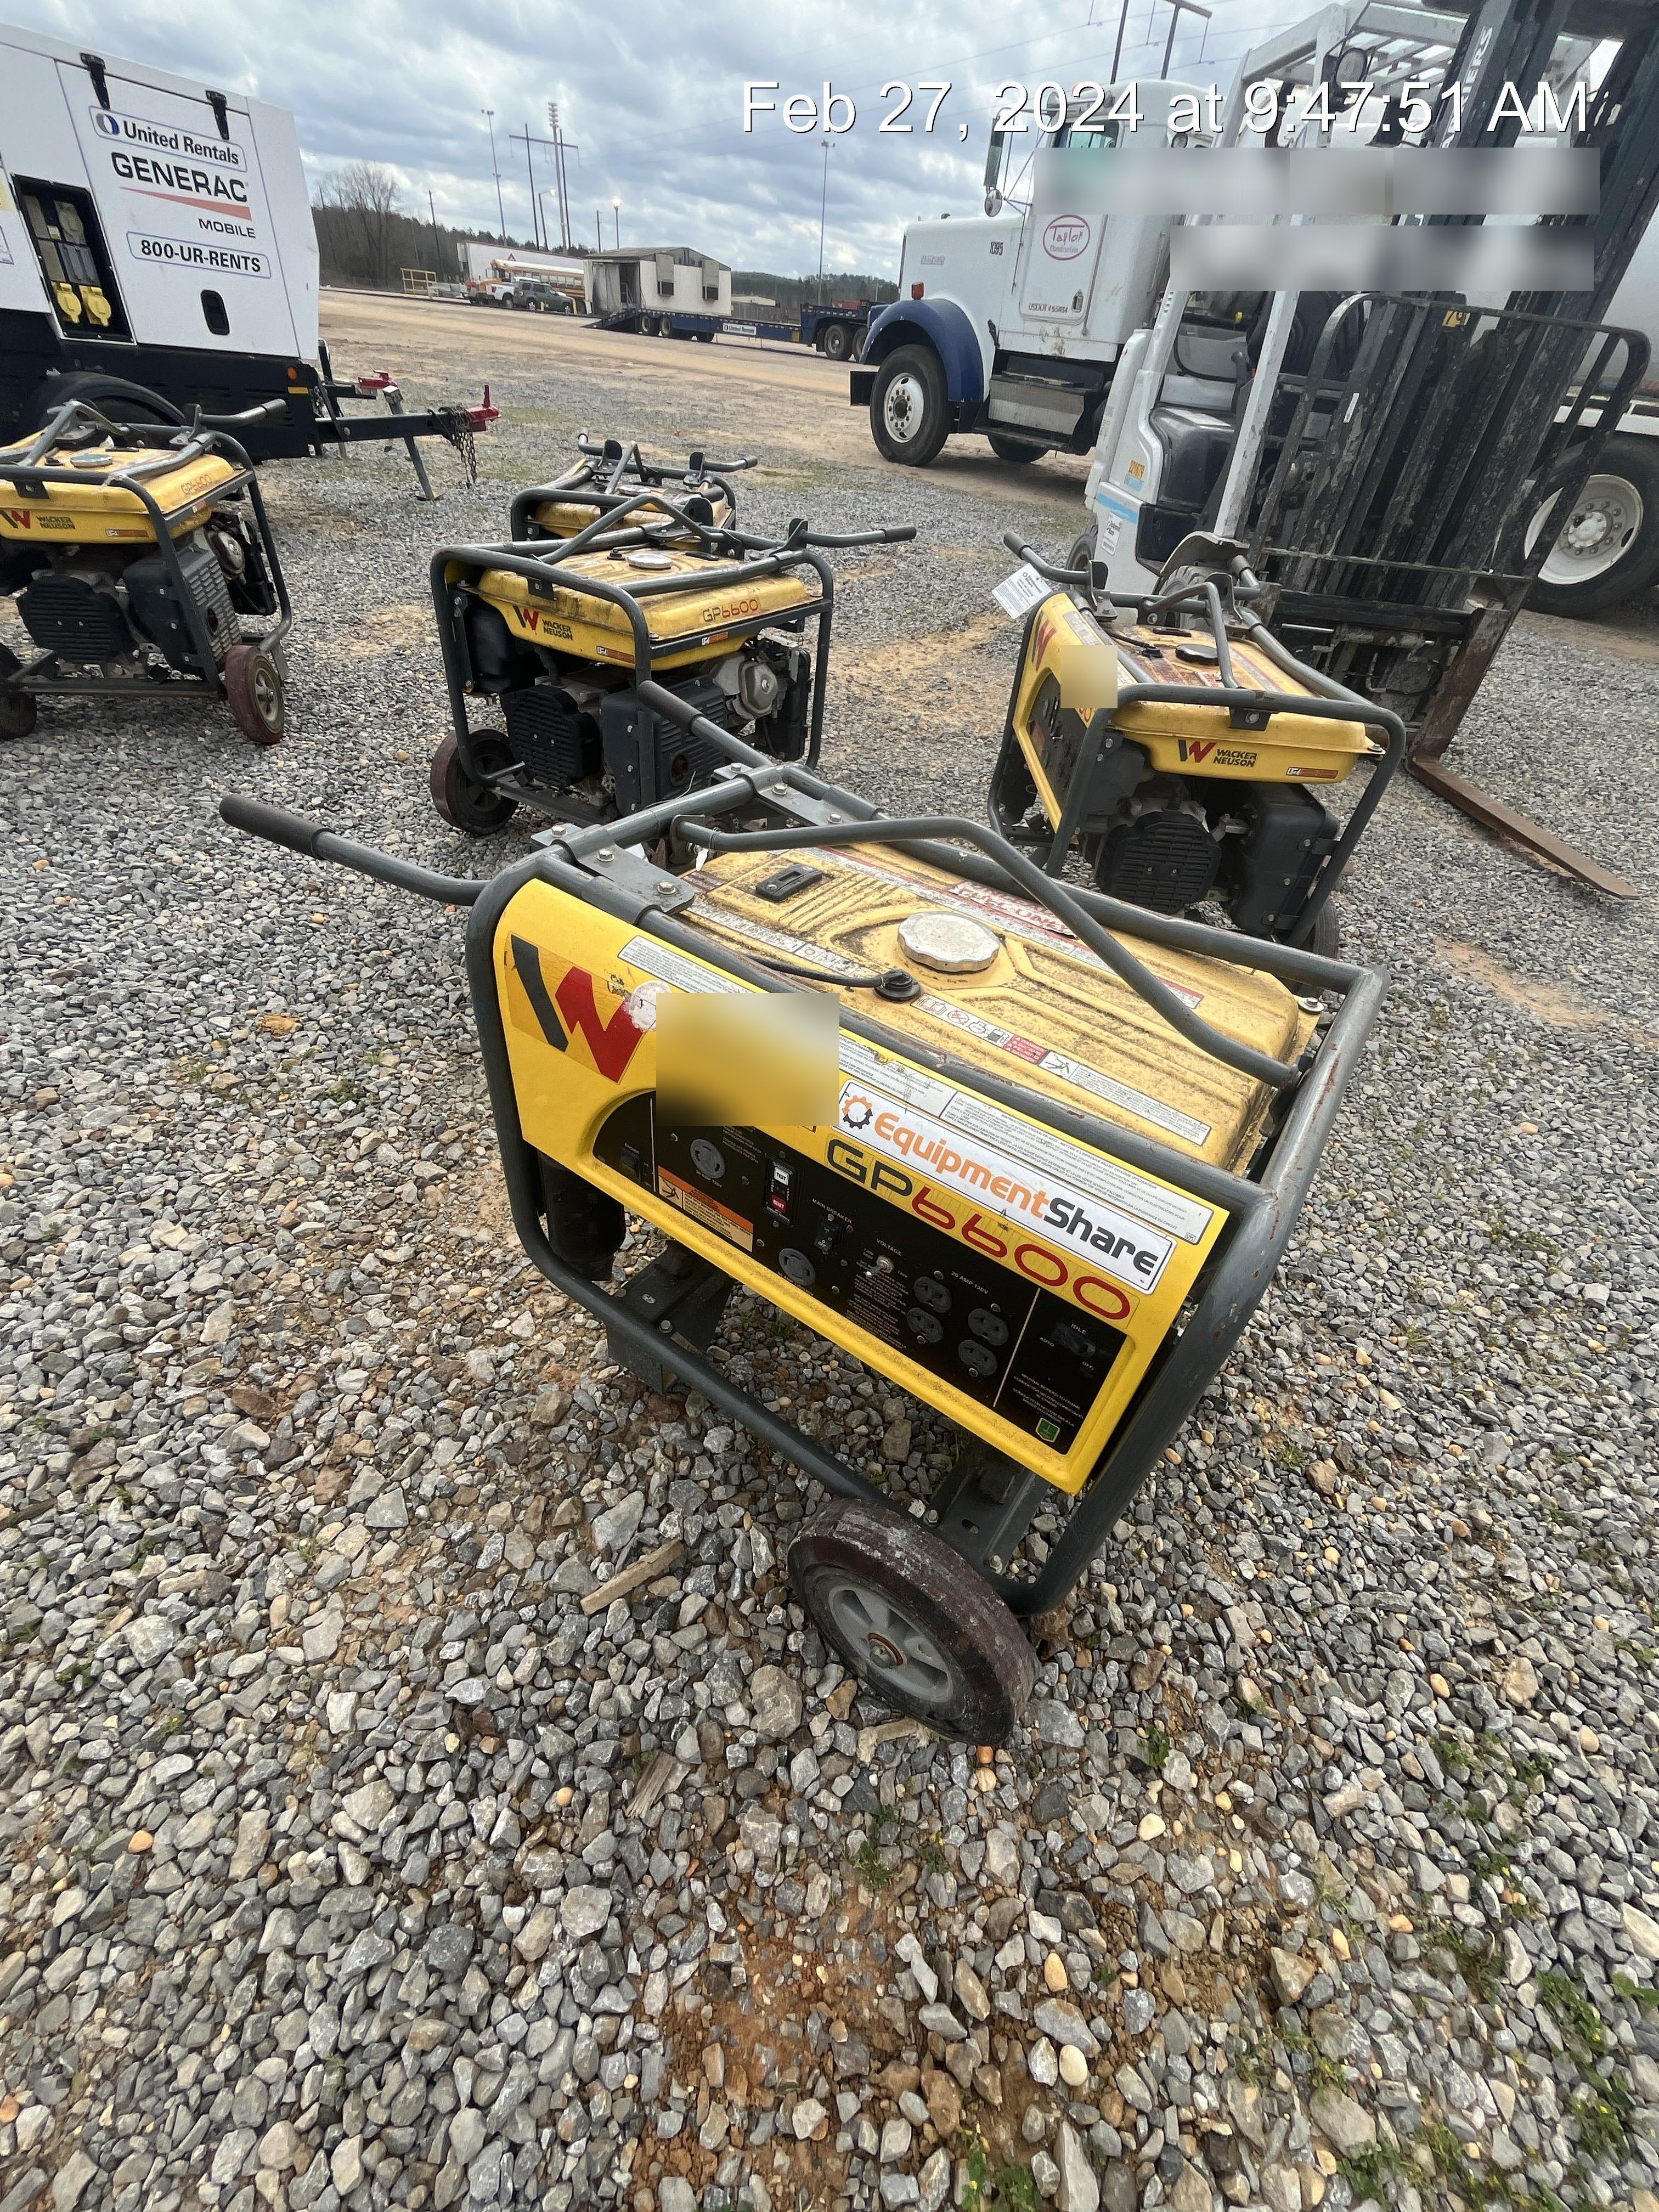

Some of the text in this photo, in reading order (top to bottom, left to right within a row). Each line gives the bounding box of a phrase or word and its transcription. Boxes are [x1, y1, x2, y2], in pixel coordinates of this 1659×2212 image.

[123, 122, 239, 165] United Rentals
[112, 153, 247, 202] GENERAC
[199, 218, 256, 239] MOBILE
[1049, 224, 1085, 246] Taylor
[141, 239, 261, 273] 800-UR-RENTS
[990, 241, 1003, 255] 1095
[542, 619, 571, 632] WACKER
[543, 626, 573, 640] NEUSON
[1213, 756, 1255, 768] NEUSON
[1216, 749, 1257, 760] WACKER
[776, 1172, 786, 1181] TEST
[874, 1110, 1158, 1276] EquipmentShare
[812, 1198, 852, 1224] MAIN BREAKER
[827, 1138, 1130, 1320] GP6600
[877, 1239, 902, 1256] VOLTAGE
[960, 1276, 973, 1285] AMP
[974, 1284, 988, 1294] 120V
[1070, 1323, 1087, 1335] IDLE
[1039, 1336, 1055, 1347] AUTO
